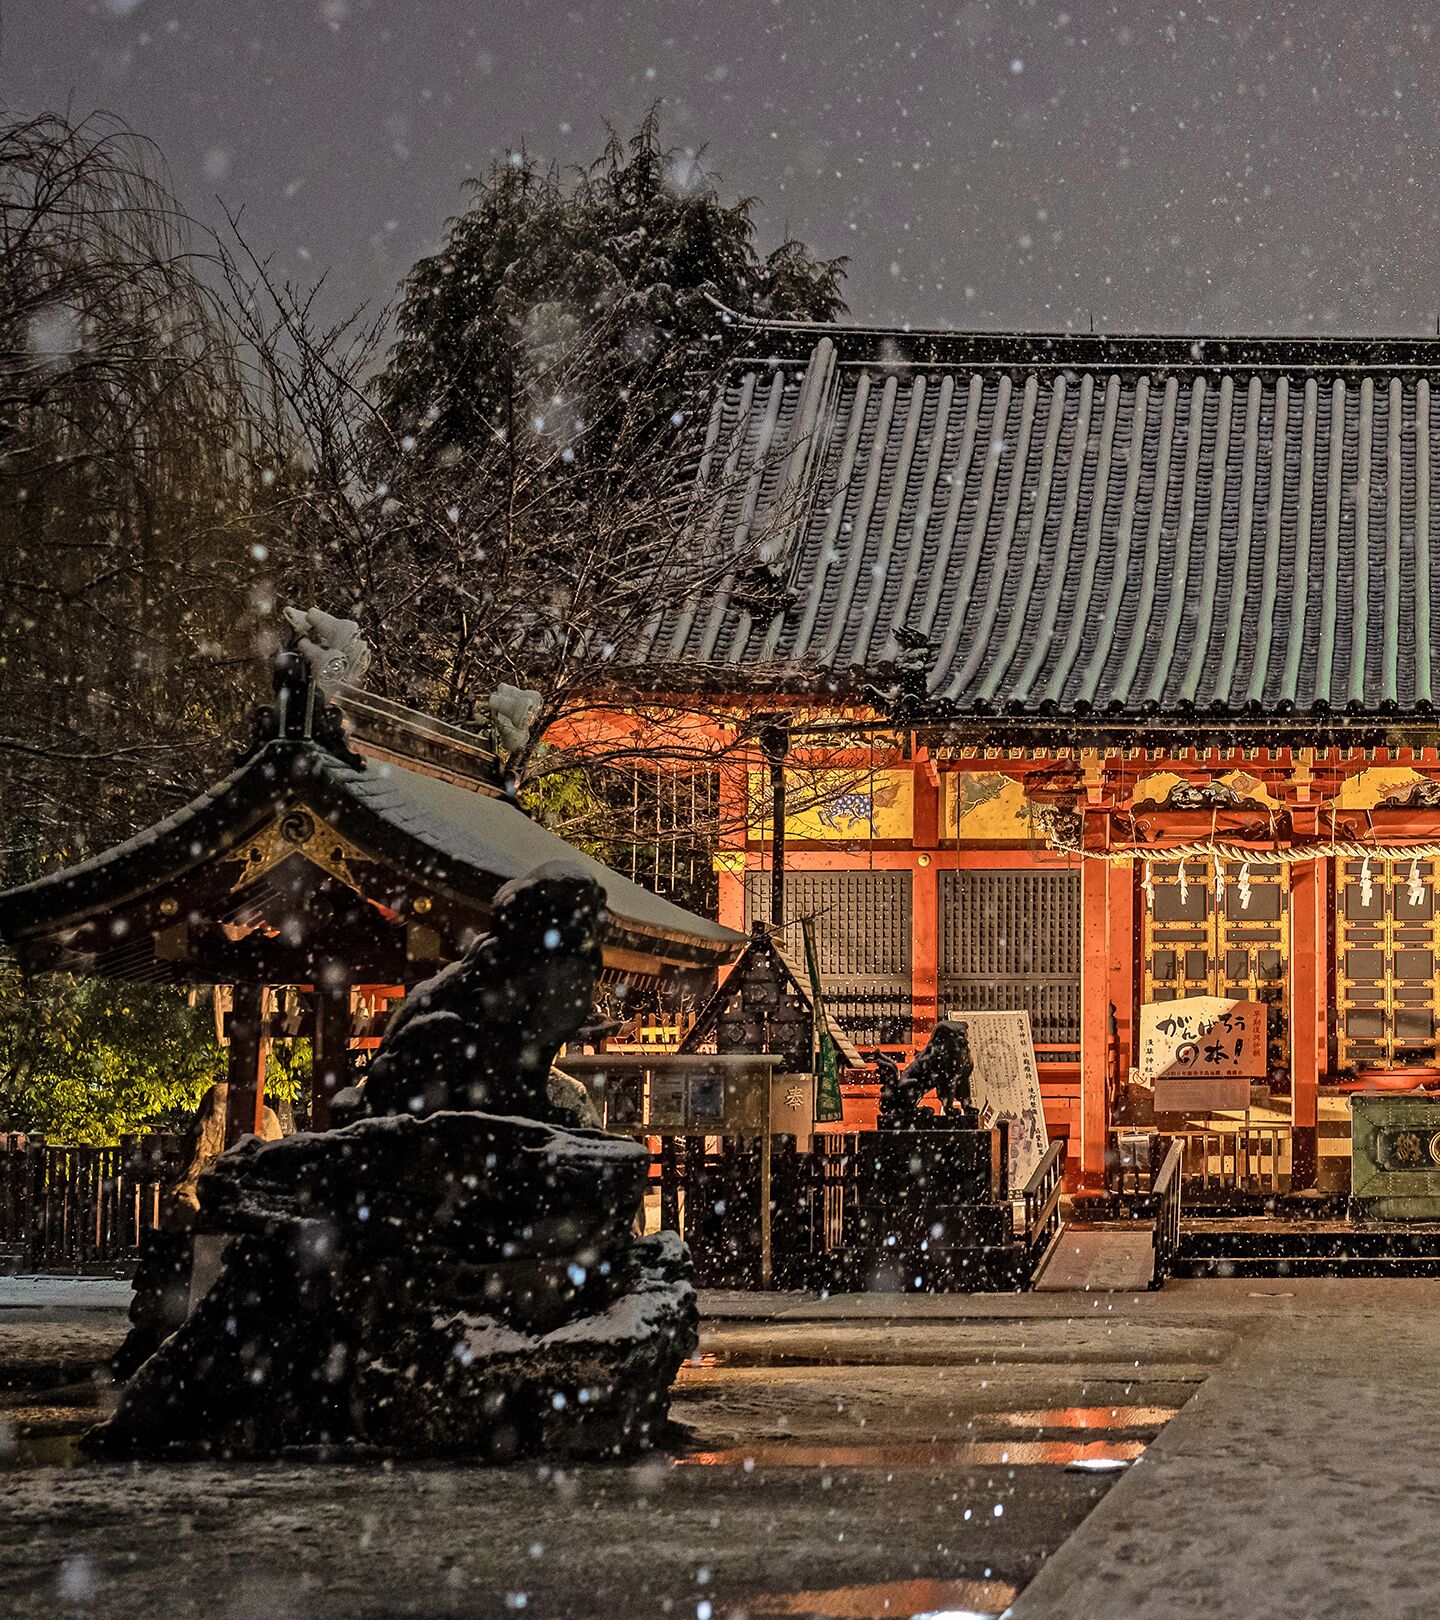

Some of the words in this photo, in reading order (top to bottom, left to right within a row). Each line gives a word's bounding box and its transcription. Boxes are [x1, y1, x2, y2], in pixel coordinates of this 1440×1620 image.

[1155, 1013, 1246, 1040] がんばろう
[1145, 1039, 1154, 1073] 浅草神社
[784, 1085, 804, 1111] 奉
